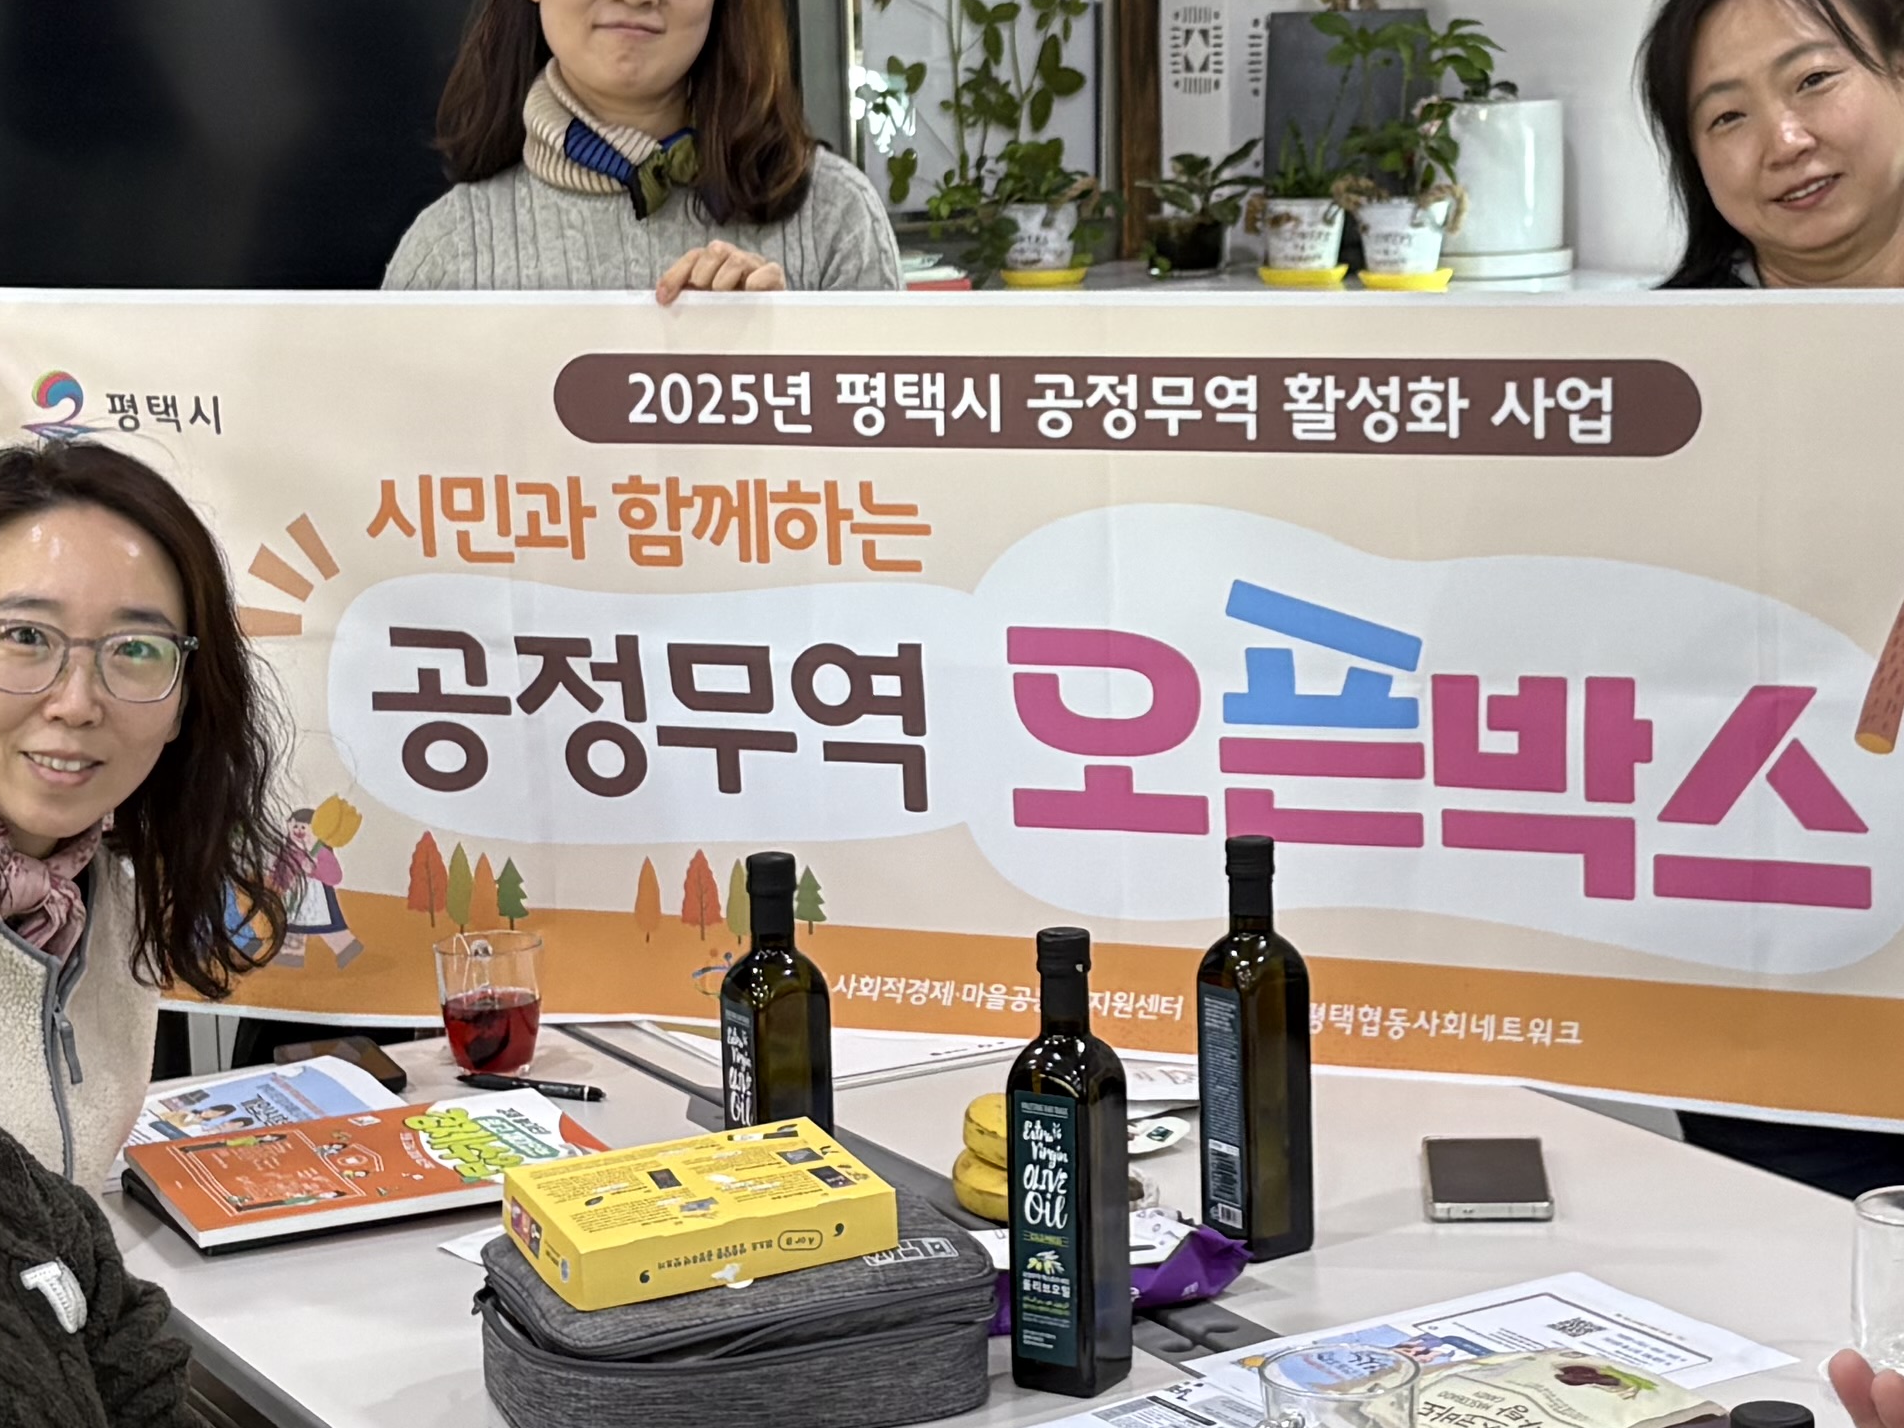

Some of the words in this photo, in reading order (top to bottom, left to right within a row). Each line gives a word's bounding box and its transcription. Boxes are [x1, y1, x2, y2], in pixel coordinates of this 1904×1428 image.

[105, 389, 223, 435] 평택시
[628, 372, 812, 436] 2025년
[836, 373, 1001, 437] 평택시
[1028, 375, 1257, 440] 공정무역
[1284, 376, 1468, 442] 활성화
[1489, 377, 1615, 444] 사업
[368, 475, 596, 563] 시민과
[613, 476, 932, 572] 함께하는
[371, 625, 928, 814] 공정무역
[1007, 578, 1873, 910] 오픈박스
[833, 974, 1185, 1022] 사회적경제·마을공지원센터
[1023, 1163, 1068, 1195] OLIVE
[1031, 1141, 1069, 1170] Virgin
[1024, 1190, 1068, 1229] Oil
